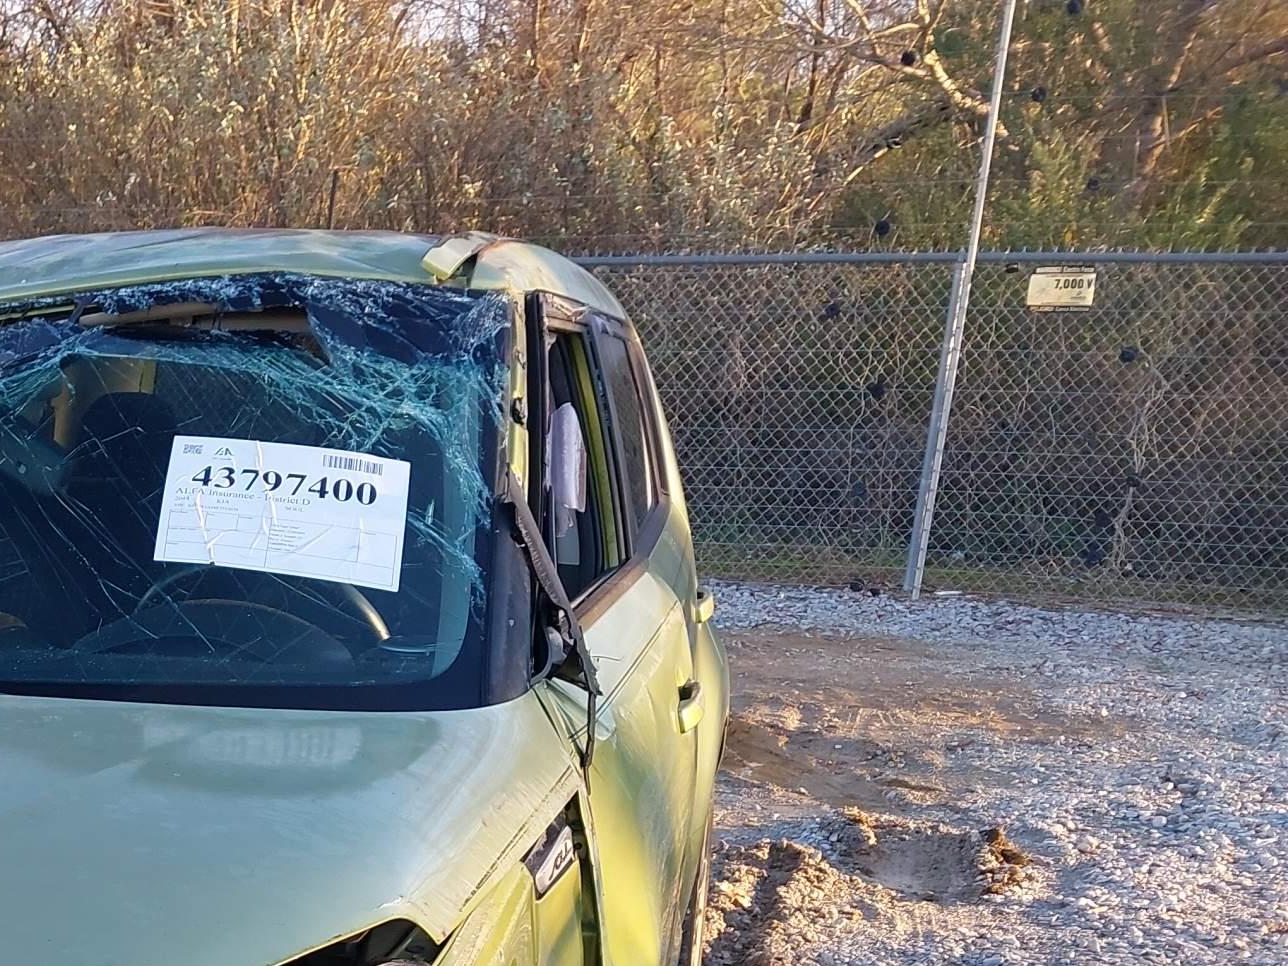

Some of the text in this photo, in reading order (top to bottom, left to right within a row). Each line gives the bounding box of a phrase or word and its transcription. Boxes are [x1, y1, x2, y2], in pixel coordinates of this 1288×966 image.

[1054, 278, 1093, 290] 7,000 V
[192, 465, 378, 506] 43797400
[209, 488, 256, 500] Insurance
